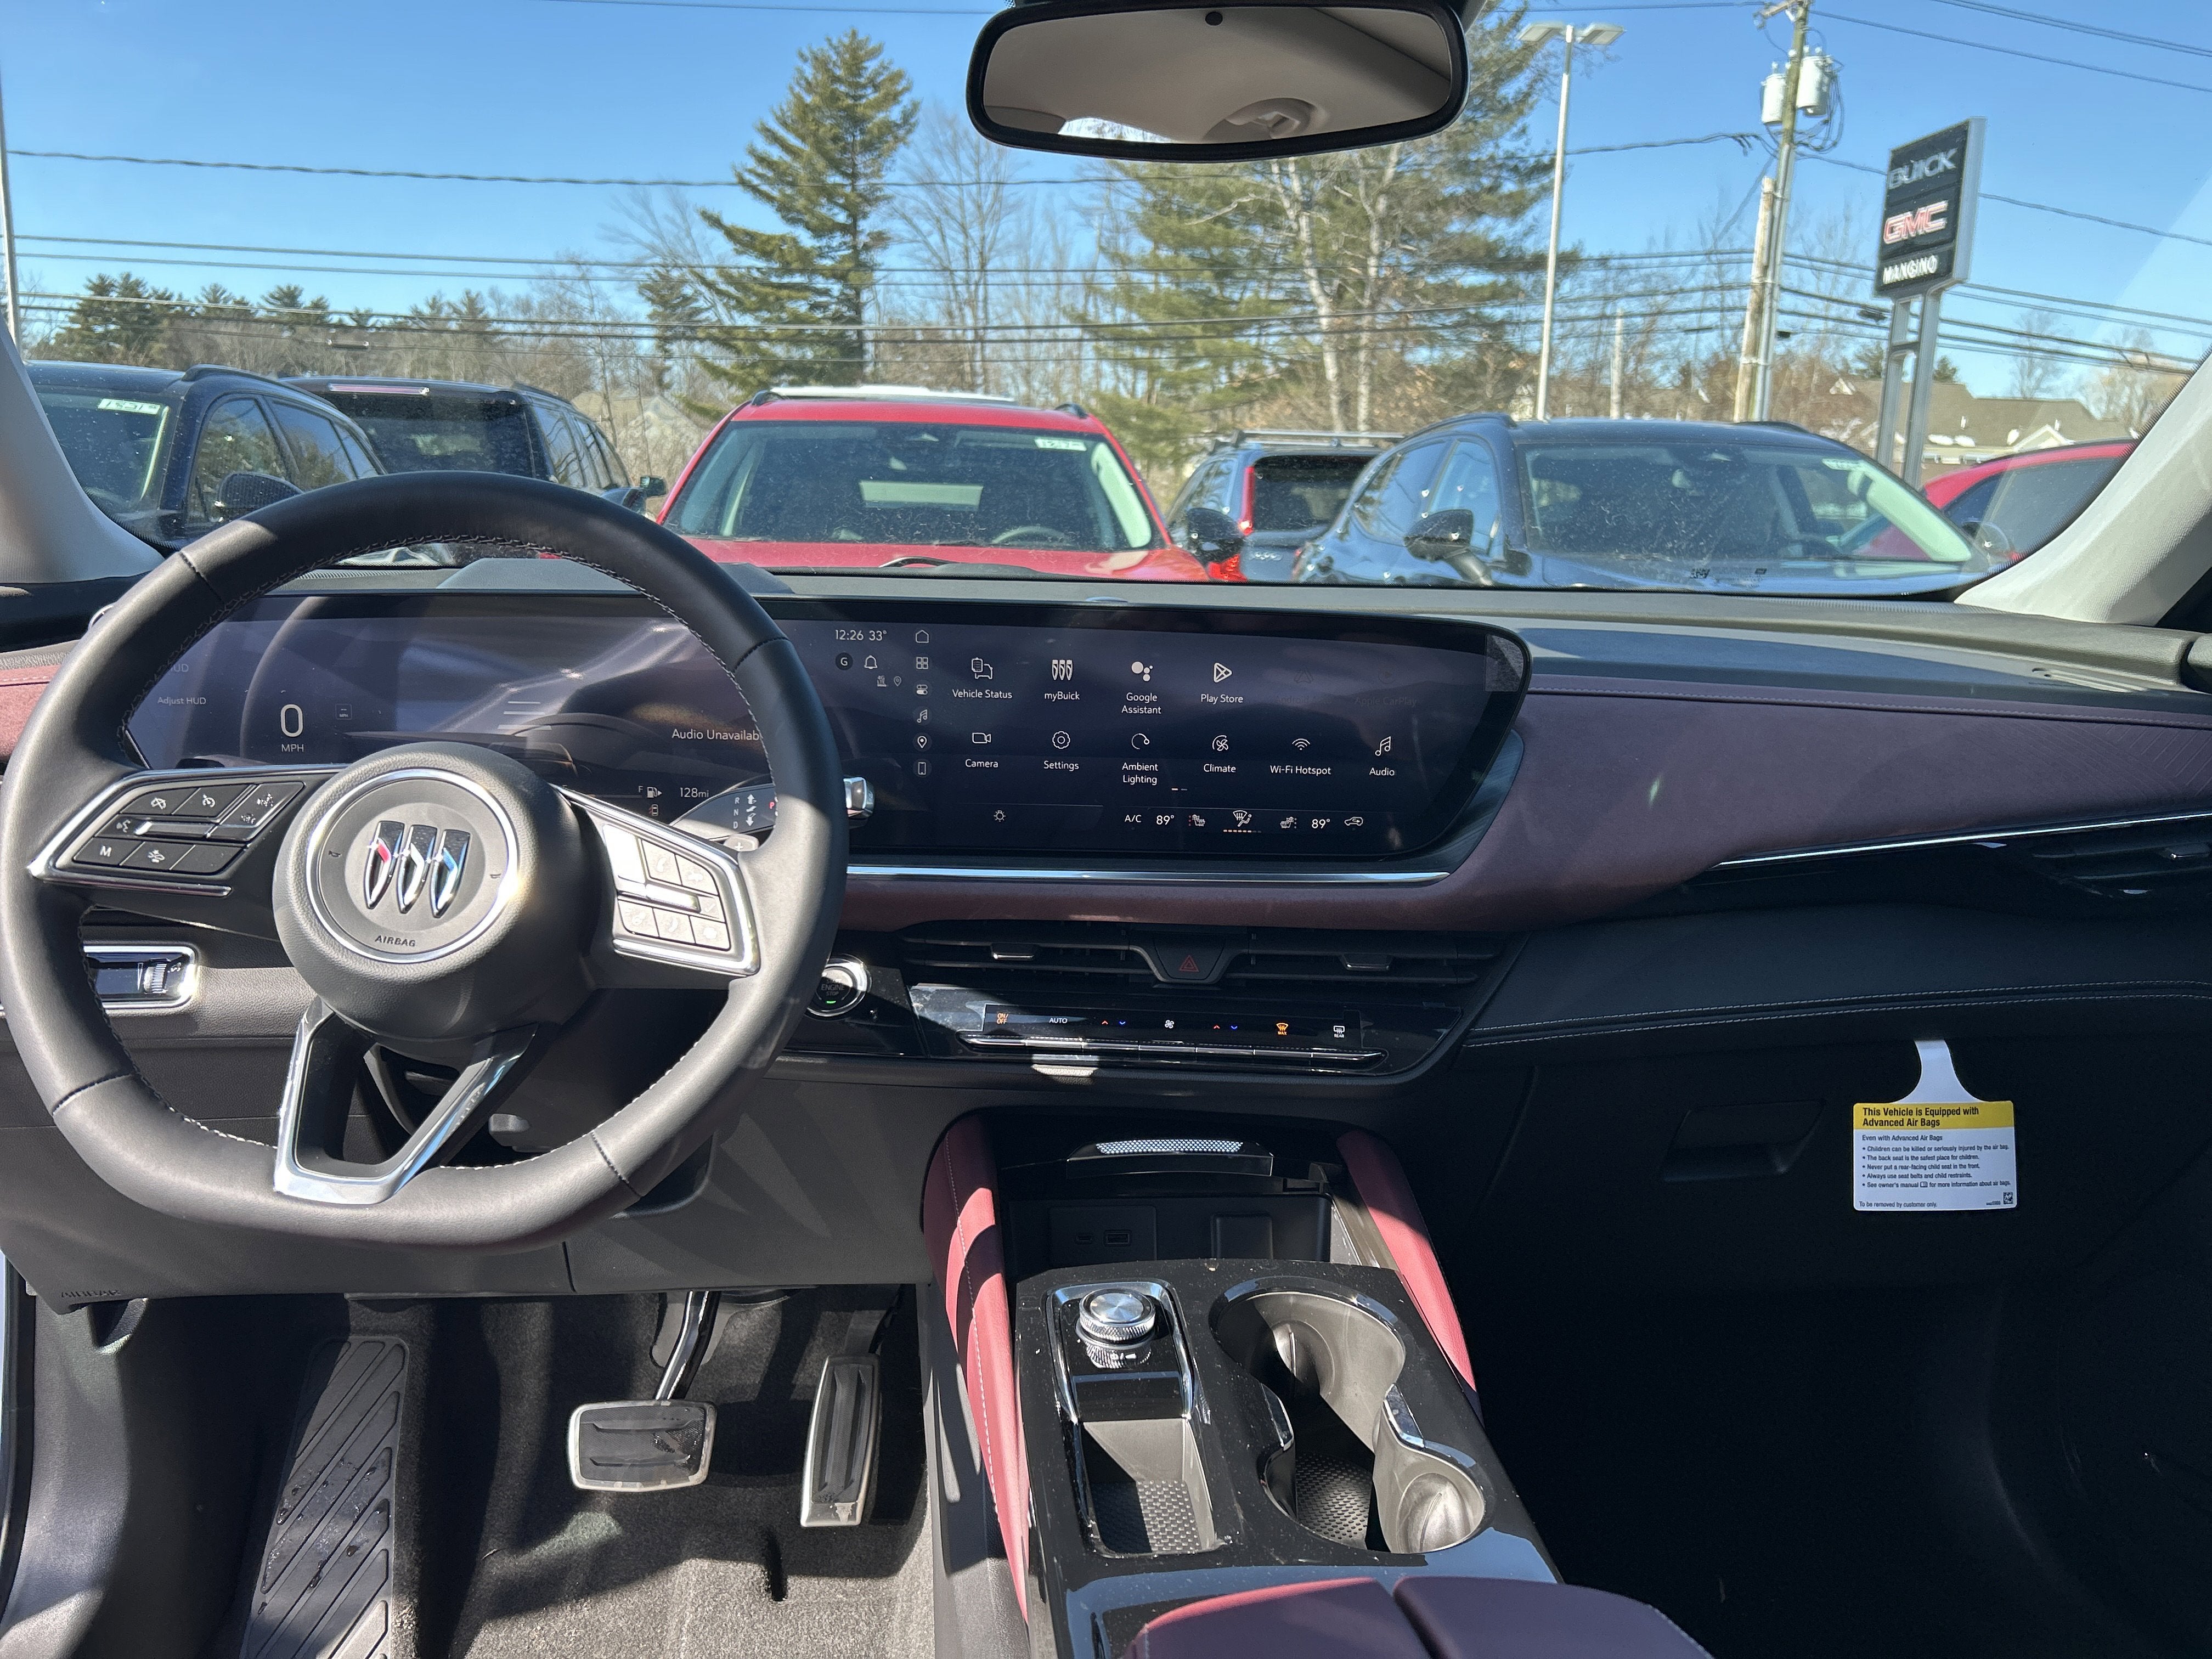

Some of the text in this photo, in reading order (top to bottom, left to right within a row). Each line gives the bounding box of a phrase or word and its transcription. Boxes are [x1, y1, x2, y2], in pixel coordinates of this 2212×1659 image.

[1888, 148, 1957, 189] BUICK
[1883, 200, 1948, 244] GMC
[835, 629, 865, 641] 12:26
[840, 657, 849, 667] G
[952, 689, 1013, 699] Vehicle Status
[1044, 691, 1080, 702] myBuick
[1126, 692, 1158, 703] Google
[1200, 693, 1244, 704] Play Store
[156, 696, 207, 707] Adjust HUD
[1121, 706, 1162, 714] Assistant
[280, 703, 304, 737] 0
[671, 728, 704, 741] Audio
[281, 743, 305, 753] MPH
[965, 758, 999, 769] Camera
[1043, 760, 1080, 772] Settings
[1121, 762, 1159, 771] Ambient
[1203, 763, 1237, 773] Climate
[1269, 765, 1331, 776] Wi-Fi Hotspot
[1369, 767, 1395, 776] Audio
[1122, 775, 1158, 786] Lighting
[1124, 814, 1142, 823] A/C
[99, 845, 112, 857] M
[375, 934, 416, 947] AIRBAG
[1863, 1107, 1881, 1116] This
[1883, 1107, 1914, 1116] Vehicle
[1925, 1107, 1961, 1118] Equipped
[1962, 1106, 1979, 1115] with
[1863, 1118, 1940, 1127] Advanced Air Bags
